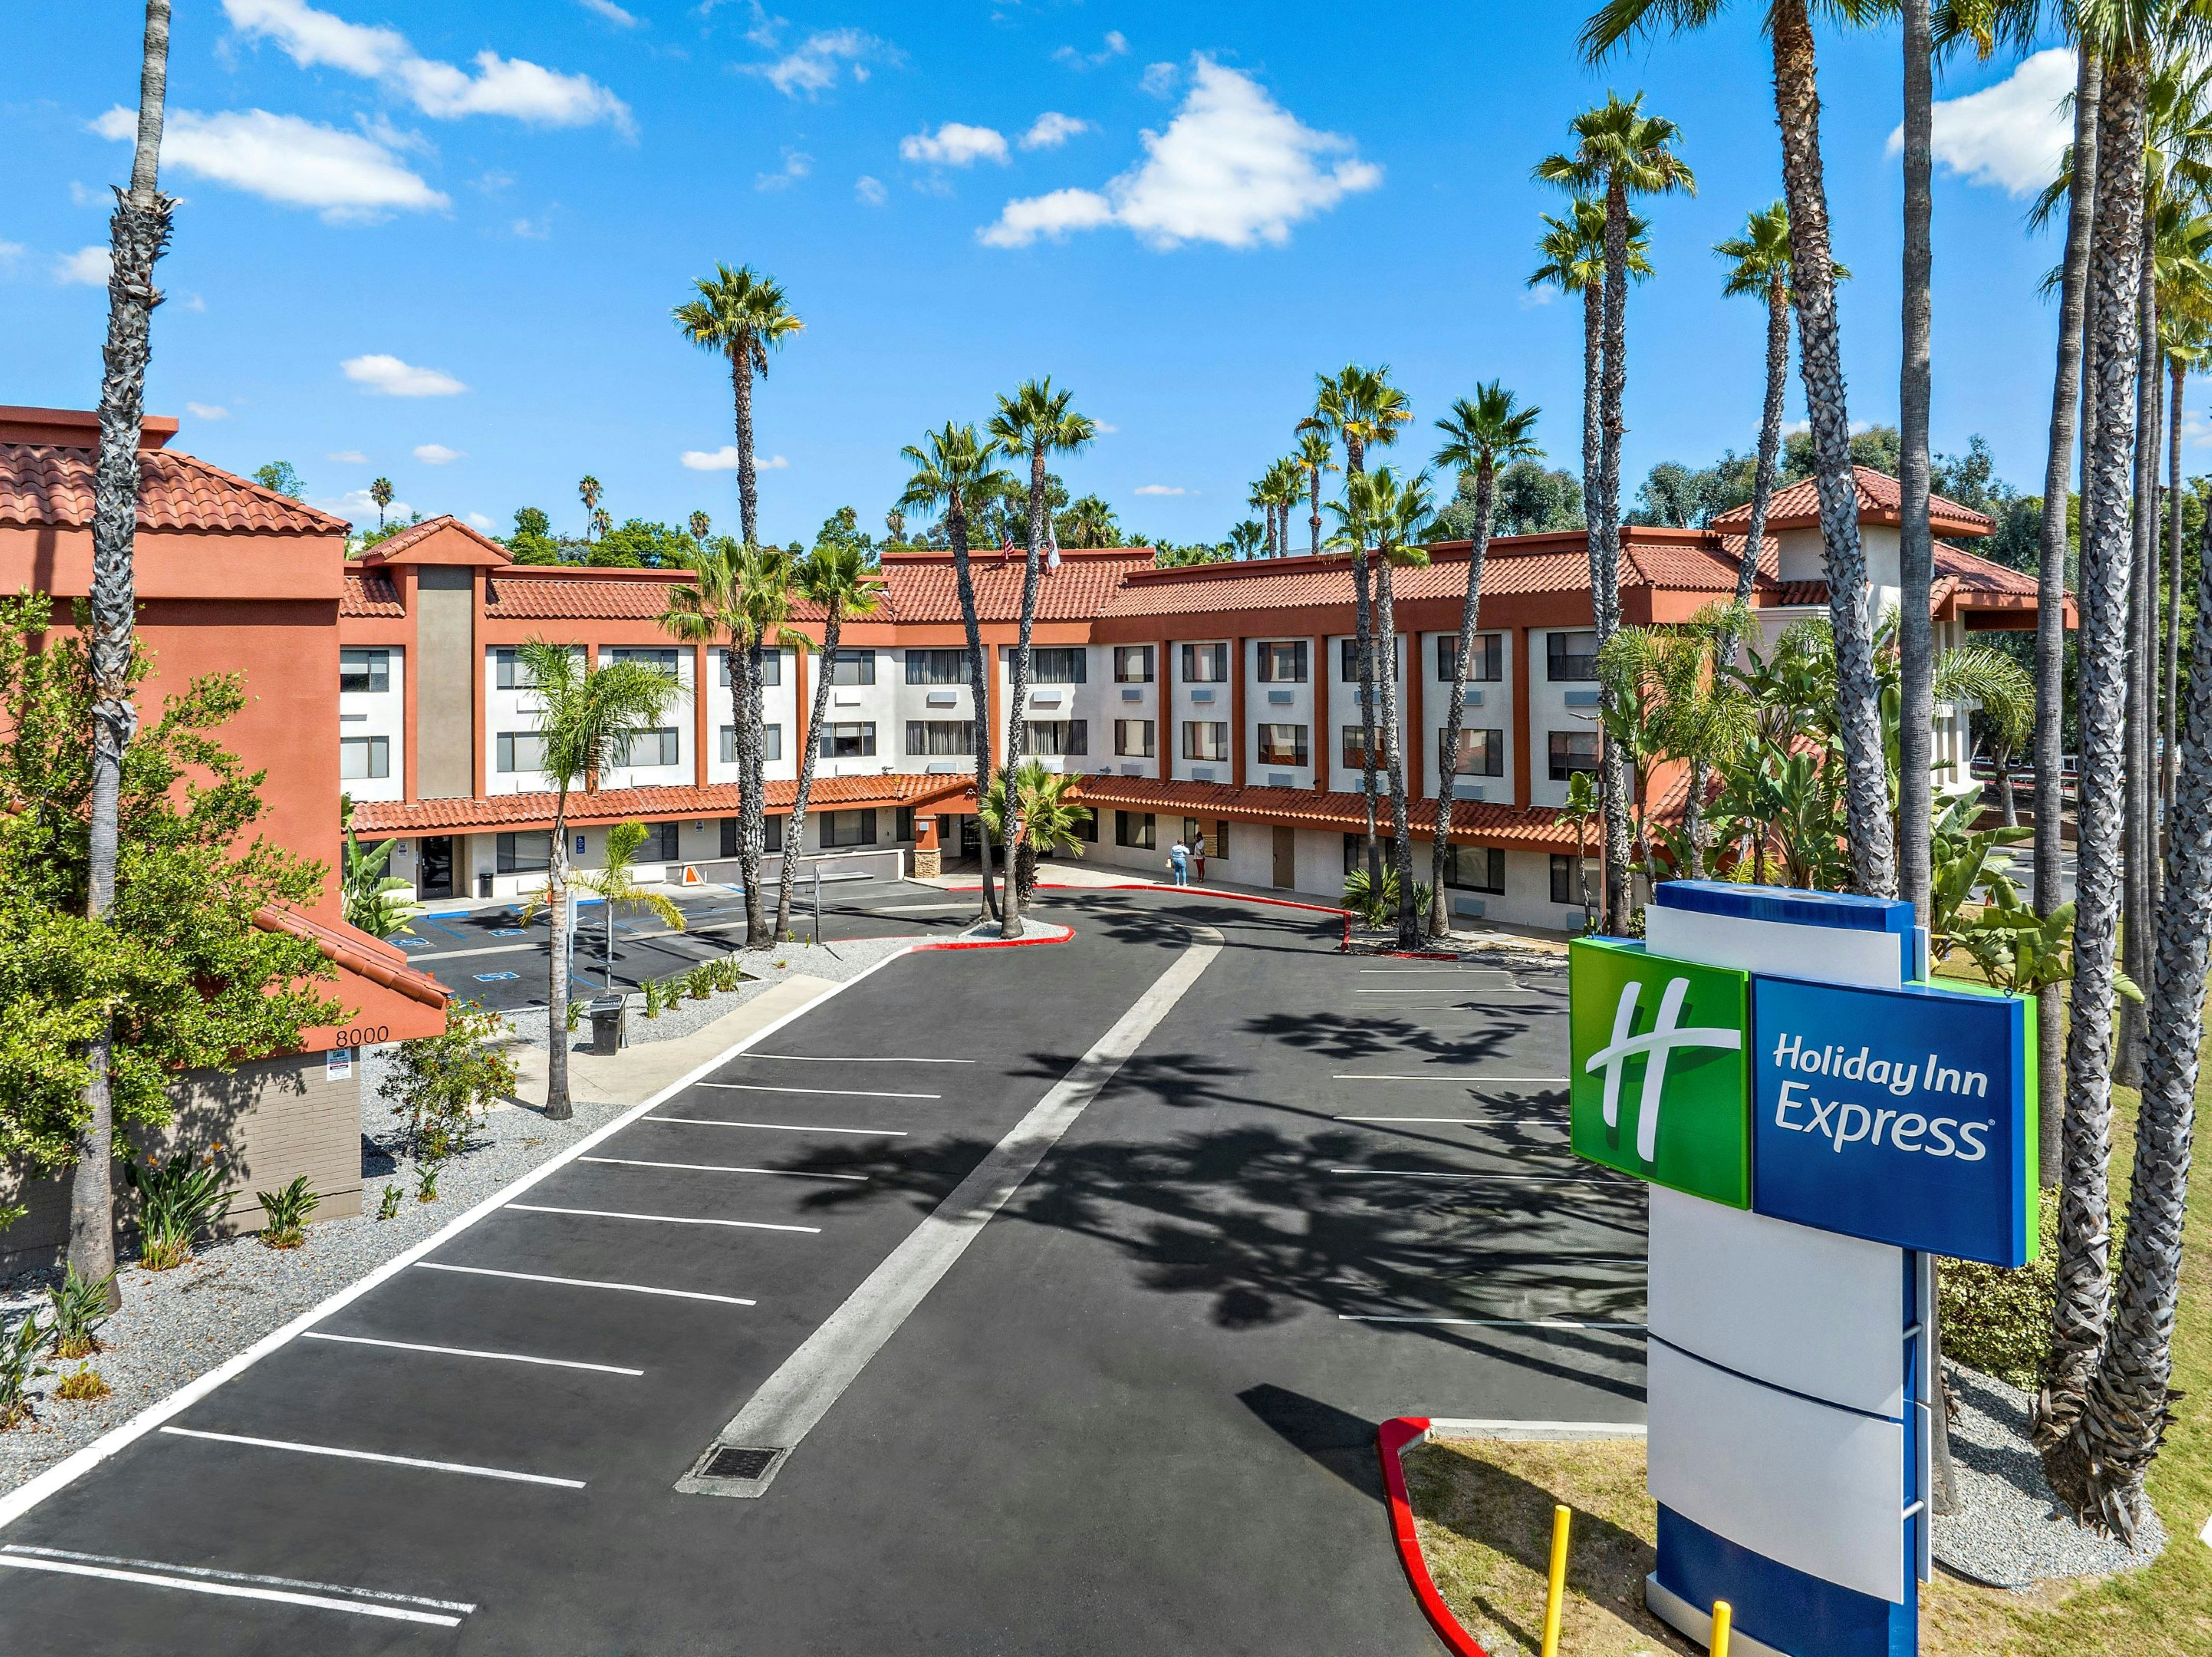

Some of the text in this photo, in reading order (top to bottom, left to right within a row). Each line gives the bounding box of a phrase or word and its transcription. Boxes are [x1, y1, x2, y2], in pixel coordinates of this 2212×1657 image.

[336, 1026, 389, 1047] 8000
[1773, 1033, 1988, 1097] Holiday Inn
